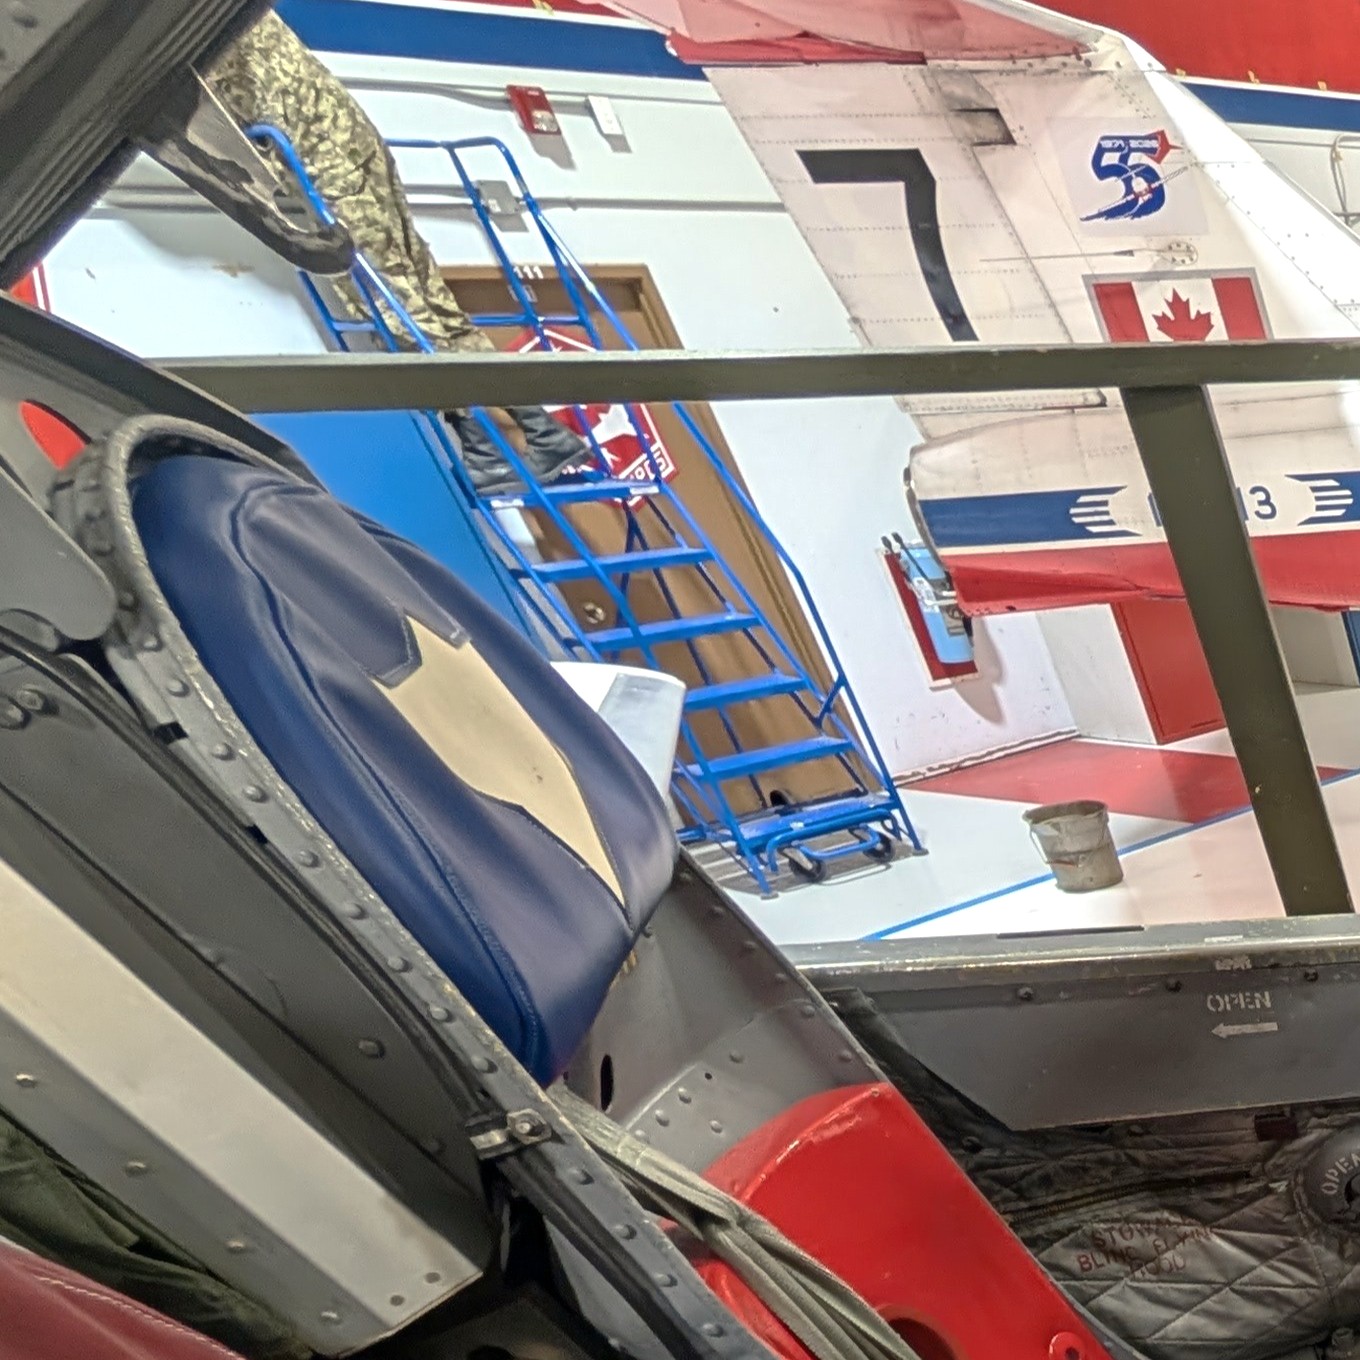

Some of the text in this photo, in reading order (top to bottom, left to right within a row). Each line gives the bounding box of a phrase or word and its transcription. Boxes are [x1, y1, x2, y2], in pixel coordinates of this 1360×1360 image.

[795, 149, 978, 341] 7
[513, 266, 544, 279] 111
[1206, 990, 1272, 1013] OPEN
